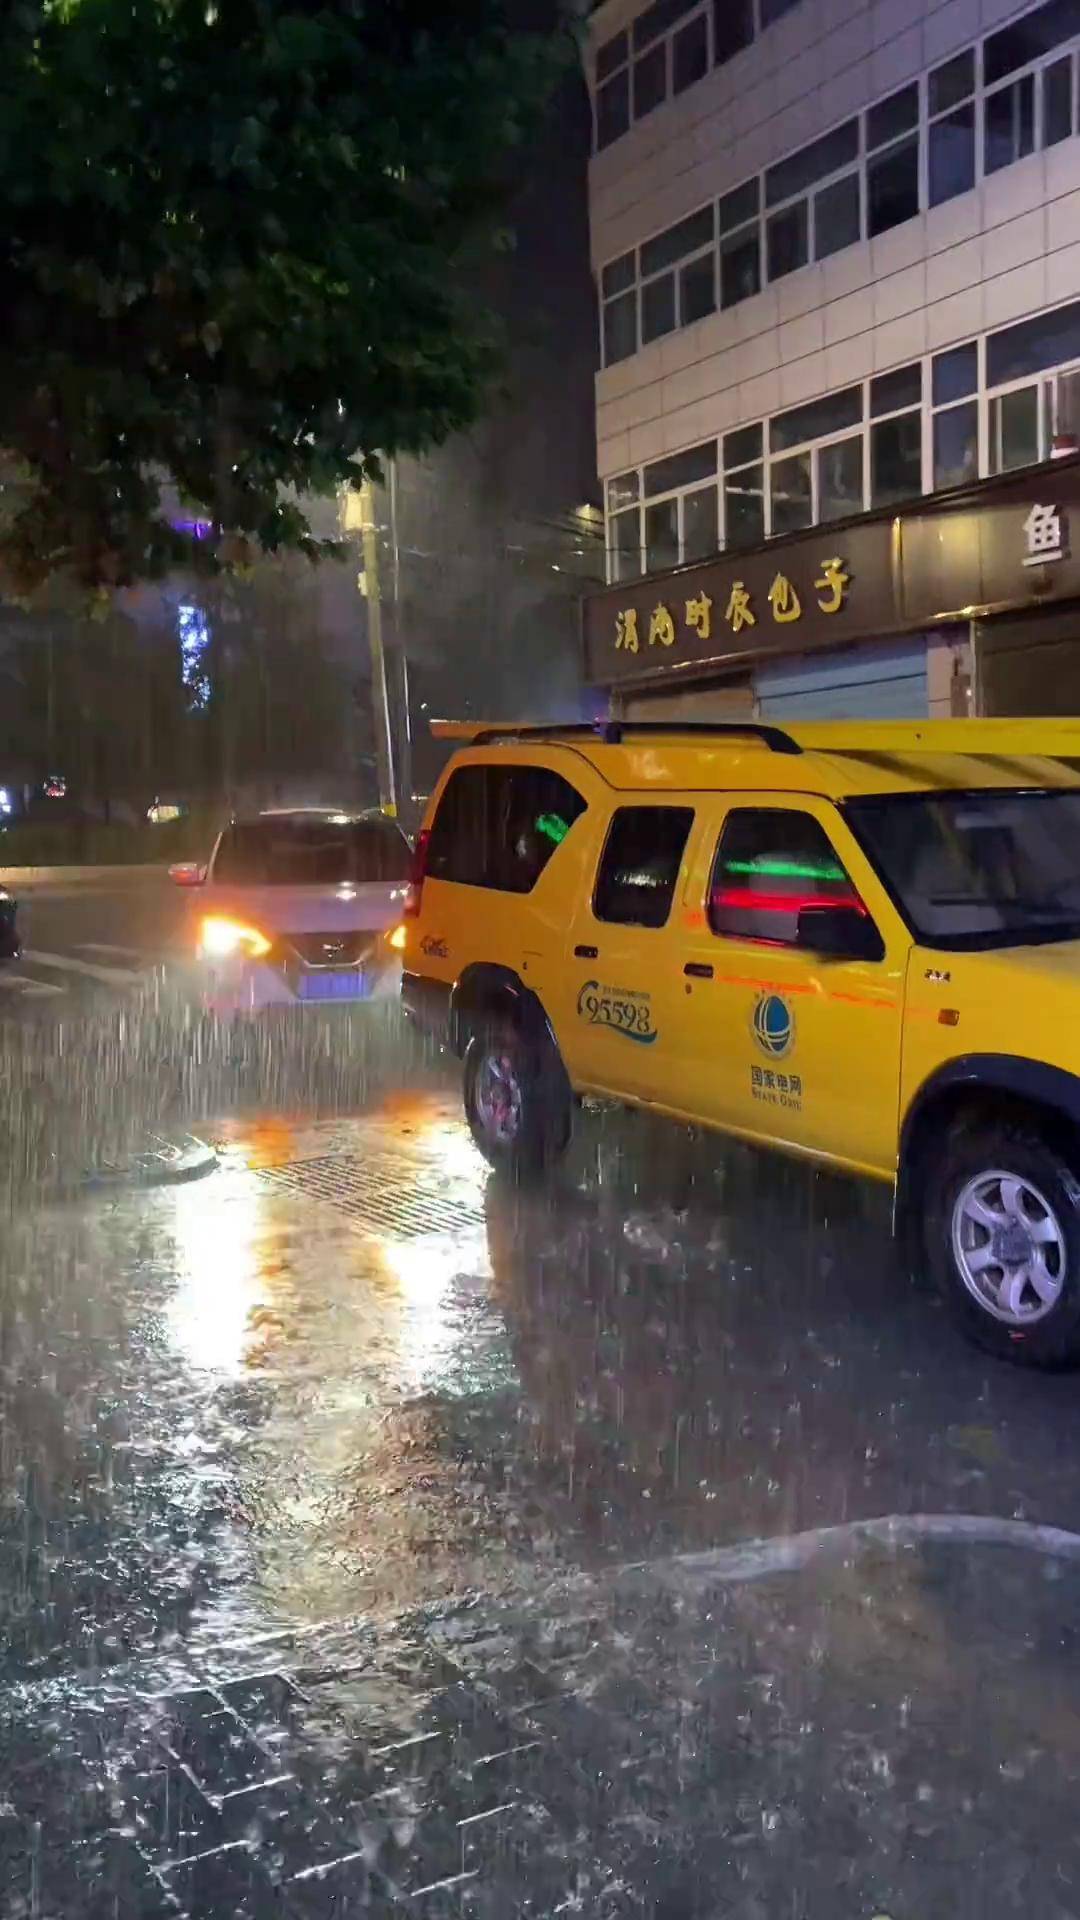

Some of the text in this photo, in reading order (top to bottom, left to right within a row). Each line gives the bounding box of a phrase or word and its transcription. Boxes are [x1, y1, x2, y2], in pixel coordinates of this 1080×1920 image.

[1022, 503, 1064, 567] 鱼
[615, 556, 850, 653] 渭南时辰包子
[587, 995, 650, 1033] 95598
[751, 1064, 802, 1097] 国家电网
